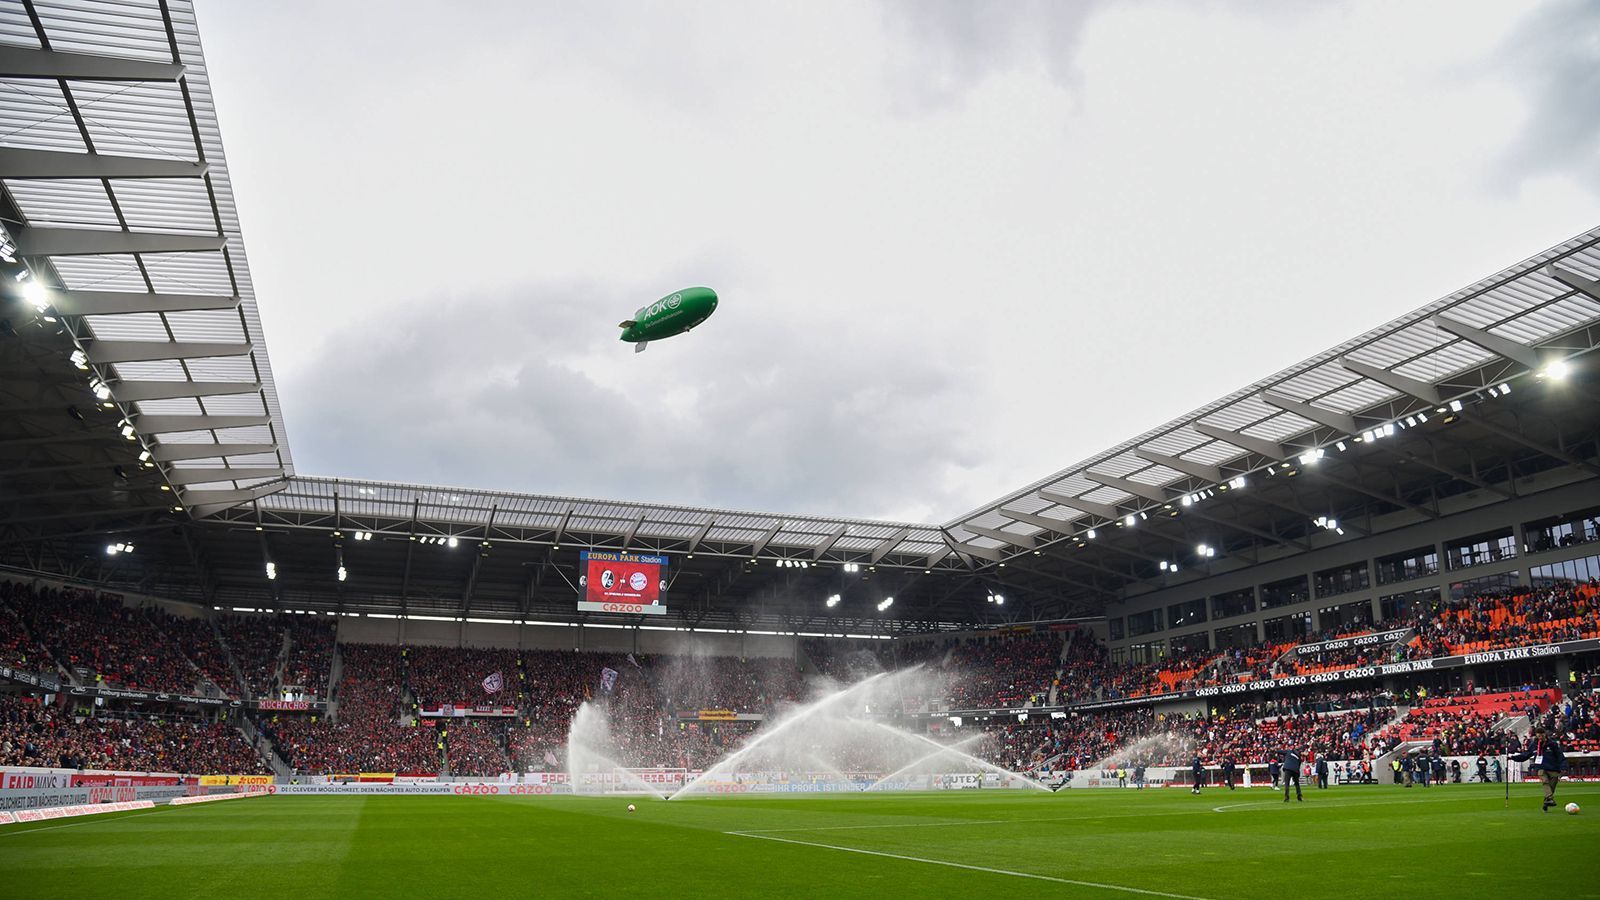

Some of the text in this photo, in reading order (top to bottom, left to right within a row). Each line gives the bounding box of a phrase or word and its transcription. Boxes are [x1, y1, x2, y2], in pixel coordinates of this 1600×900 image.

[644, 300, 668, 320] AOK
[587, 552, 662, 563] EUROPA PARK Stadion
[602, 603, 643, 613] CAZOO
[1297, 631, 1406, 655] CAZOO CAZOO CAZOO CAZO
[1464, 644, 1560, 664] EUROPA PARK Stadion
[1195, 660, 1434, 697] CAZOO CAZOO CAZOO CAZOO CAZOO CAZOO EUROPA PARK
[97, 689, 120, 698] Freiburg
[120, 689, 148, 699] verbunden
[199, 697, 223, 705] verbunden
[259, 701, 309, 710] MUCHACHOS
[247, 777, 268, 785] LOTTO
[318, 785, 360, 793] MÖGLICHKEIT,
[375, 785, 404, 793] NÄCHSTES
[454, 785, 499, 795] CAZOO
[509, 785, 553, 794] CAZOO
[708, 783, 747, 793] CAZOO
[774, 783, 790, 792] IHR
[791, 783, 821, 792] PROFIL
[823, 783, 835, 792] IST
[88, 788, 113, 804] CAZOO
[116, 788, 136, 802] CAZOO
